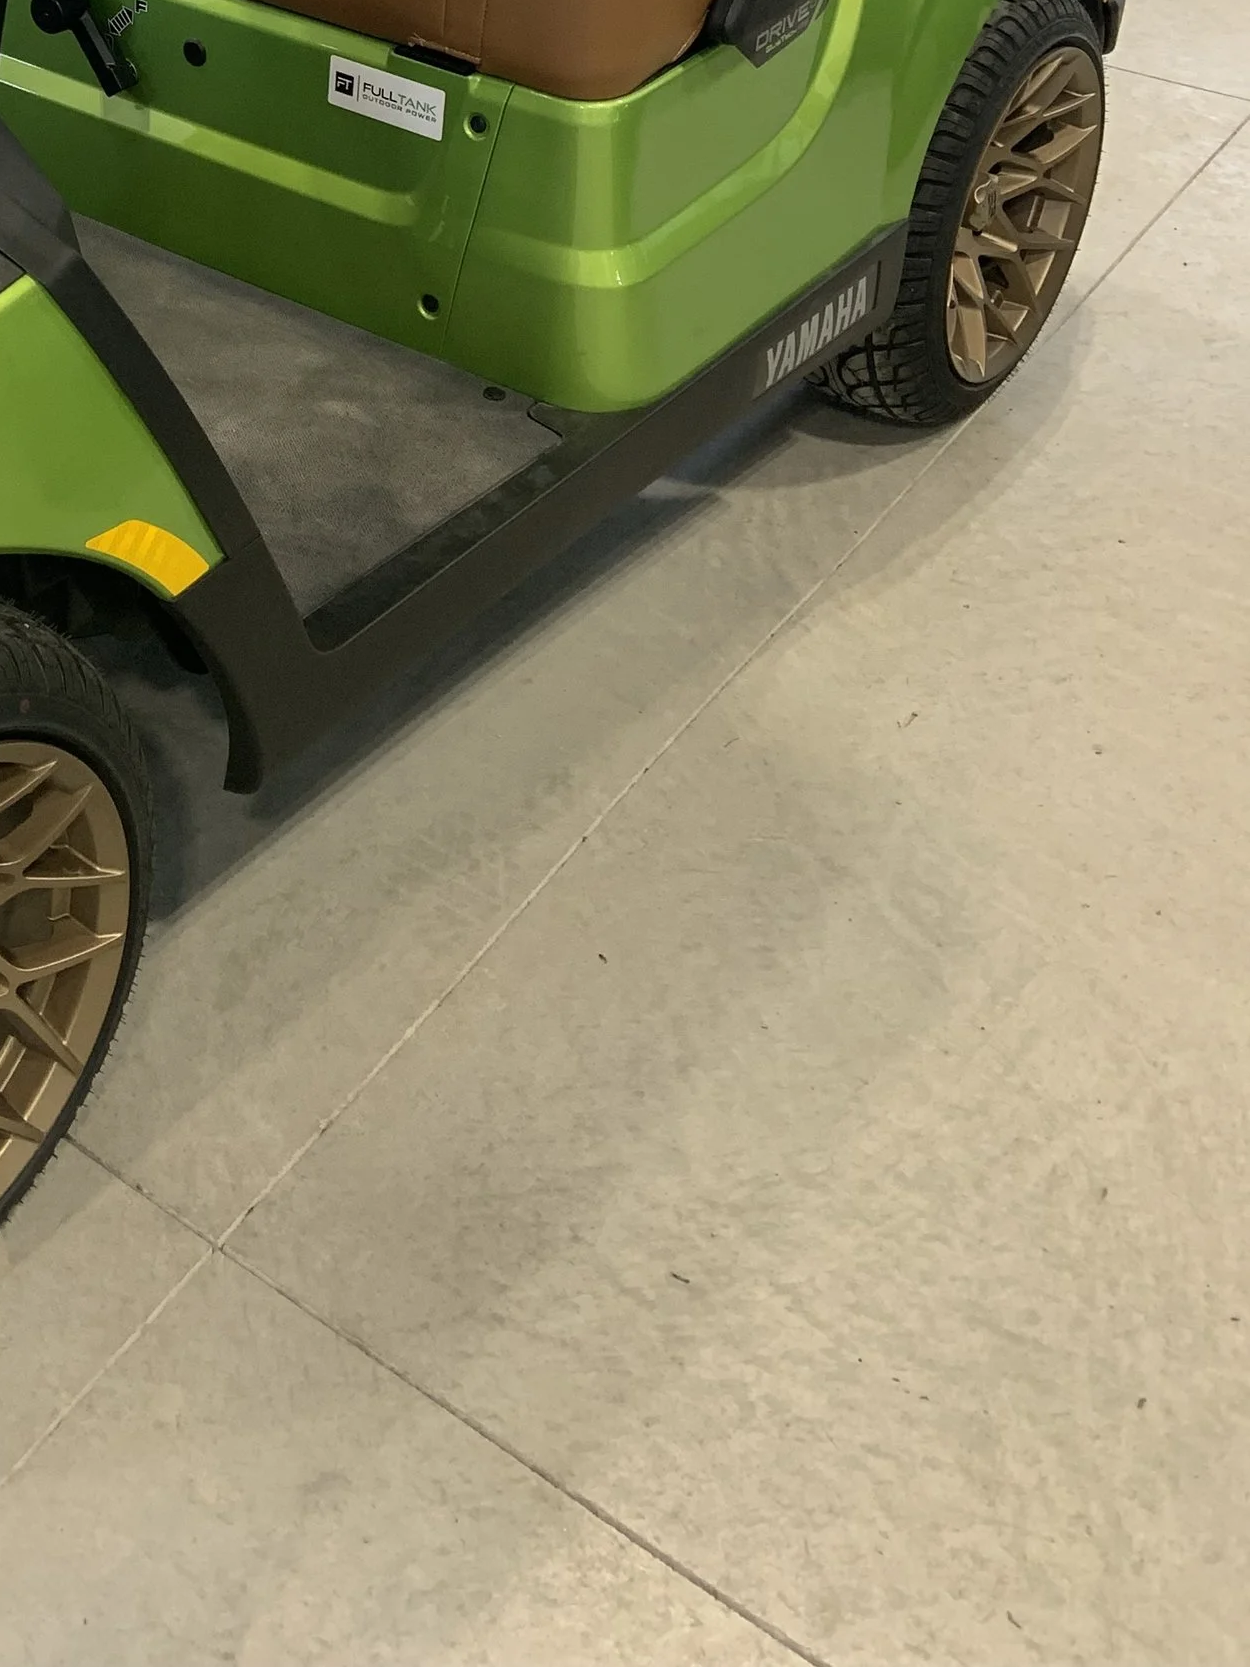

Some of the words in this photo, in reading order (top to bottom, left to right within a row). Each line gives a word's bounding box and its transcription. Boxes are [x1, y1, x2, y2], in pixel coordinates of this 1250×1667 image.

[362, 94, 404, 112] OUTDOOR
[405, 108, 438, 123] POWER
[765, 275, 868, 389] YAMAHA
